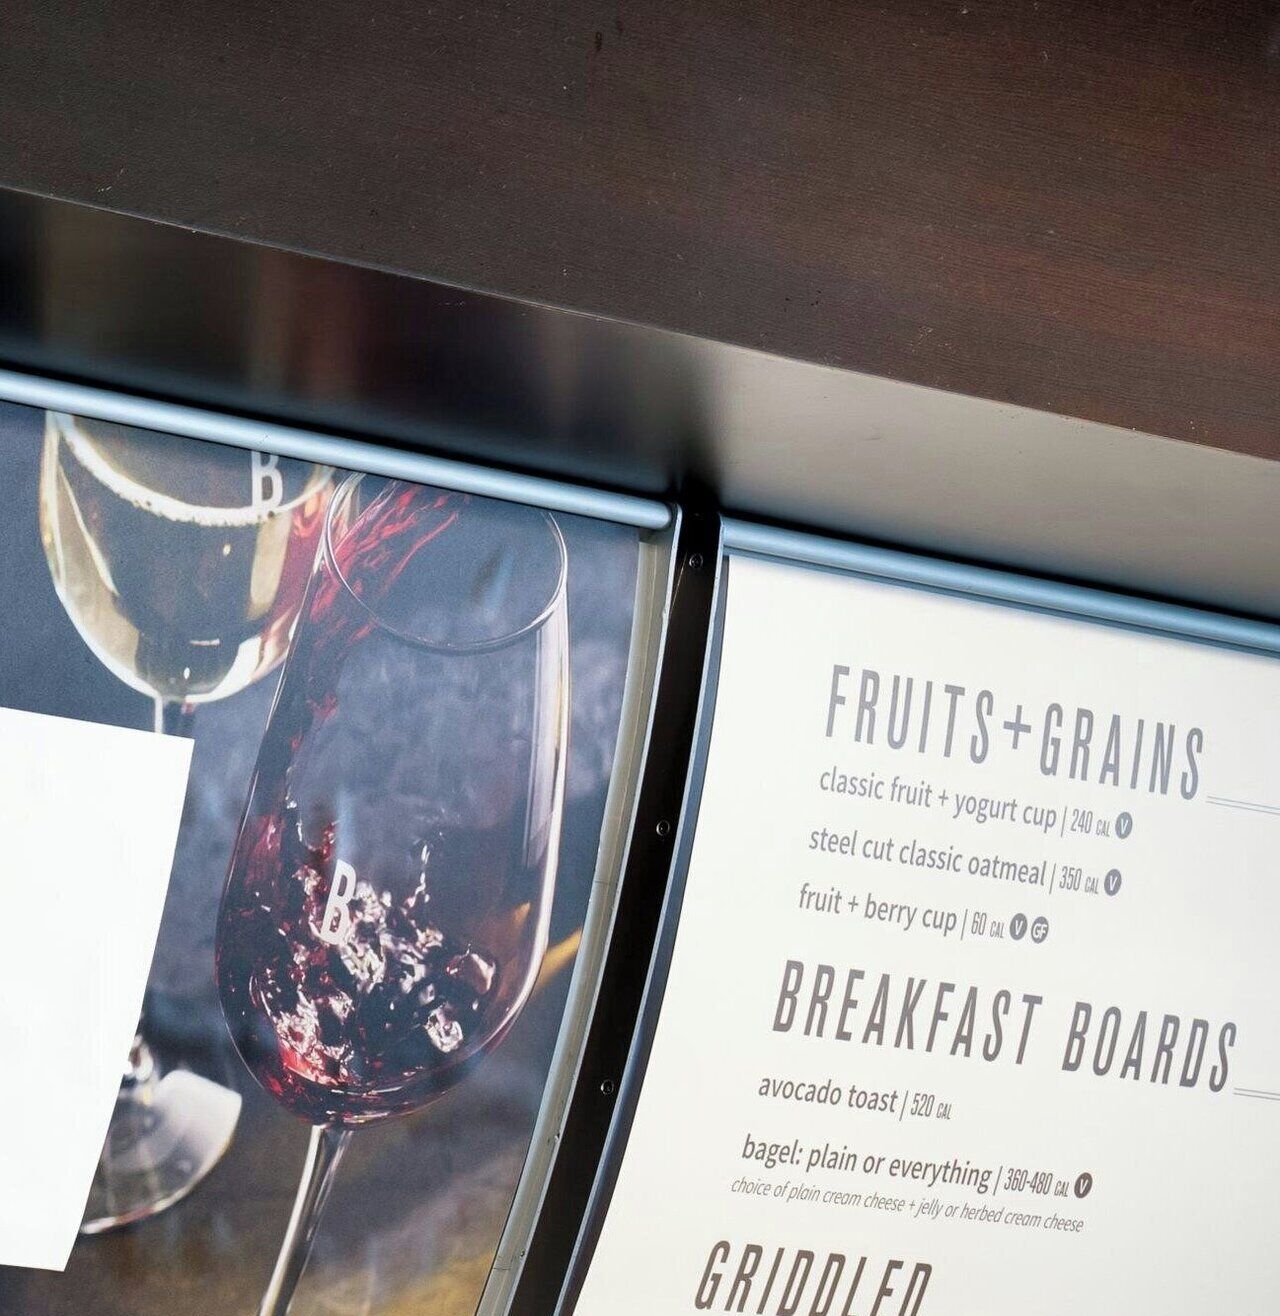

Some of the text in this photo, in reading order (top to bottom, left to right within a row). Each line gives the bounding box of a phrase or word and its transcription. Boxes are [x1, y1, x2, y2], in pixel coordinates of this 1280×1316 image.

[820, 765, 884, 799] classic
[890, 776, 932, 807] fruit
[952, 793, 1017, 824] yogurt
[1022, 805, 1056, 833] cup
[1070, 808, 1093, 833] 240
[1095, 819, 1110, 837] CAL
[808, 827, 857, 856] steel
[862, 837, 894, 862] cut
[899, 839, 962, 872] classic
[968, 855, 1046, 886] oatmeal
[1059, 865, 1082, 891] 350
[1084, 876, 1098, 894] CAL
[320, 859, 357, 945] B
[799, 882, 842, 914] fruit
[864, 892, 917, 931] berry
[922, 909, 957, 937] cup
[970, 911, 987, 935] 60
[989, 920, 1004, 938] CAL
[772, 959, 1238, 1092] BREAKFAST BOARDS
[758, 1078, 951, 1120] avocado toast 520 CAL
[741, 1133, 803, 1169] bagel:
[805, 1143, 857, 1172] plain
[862, 1155, 885, 1174] or
[888, 1158, 992, 1194] everything
[1003, 1168, 1053, 1195] 360-480
[1053, 1180, 1069, 1197] CAL
[731, 1176, 771, 1196] choice
[773, 1180, 790, 1197] of
[786, 1183, 820, 1202] plain
[822, 1190, 862, 1206] cream
[863, 1191, 905, 1211] cheese
[913, 1198, 943, 1220] jelly
[944, 1205, 959, 1217] or
[959, 1202, 1005, 1223] herbed
[1003, 1212, 1042, 1227] cream
[1043, 1212, 1084, 1232] cheese
